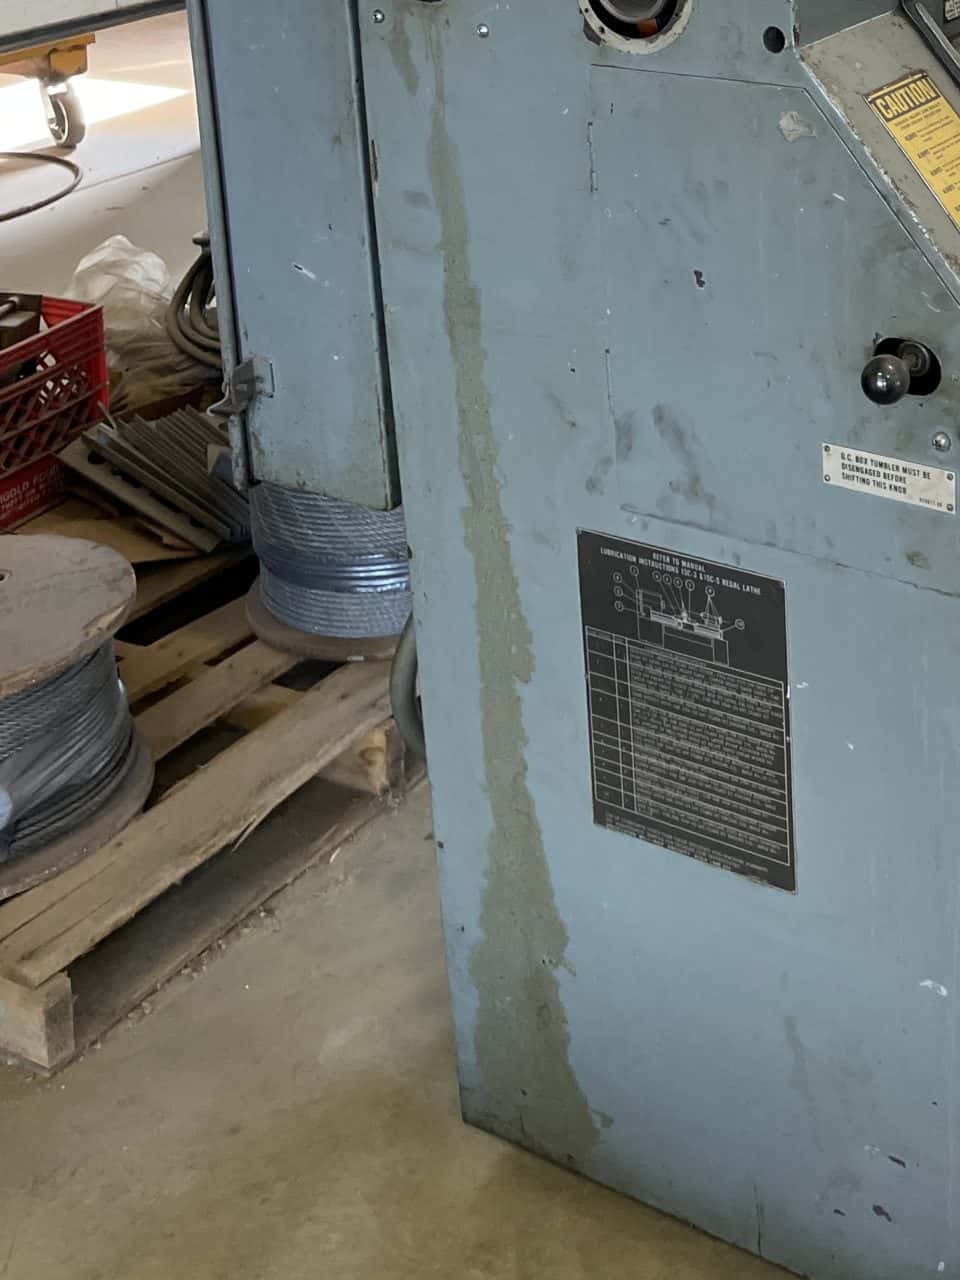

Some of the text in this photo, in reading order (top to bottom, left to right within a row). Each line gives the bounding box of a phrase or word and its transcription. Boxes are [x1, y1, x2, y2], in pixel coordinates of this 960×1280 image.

[875, 78, 937, 120] CAUTION
[841, 462, 907, 484] DISENGAGED BEFORE
[870, 458, 900, 471] TUMBLER
[902, 466, 920, 477] MUST
[842, 472, 907, 495] SHIFTING THIS KNOB
[600, 547, 637, 564] LUBRICATION
[638, 556, 679, 575] INSTRUCTIONS
[681, 558, 706, 572] MANUAL
